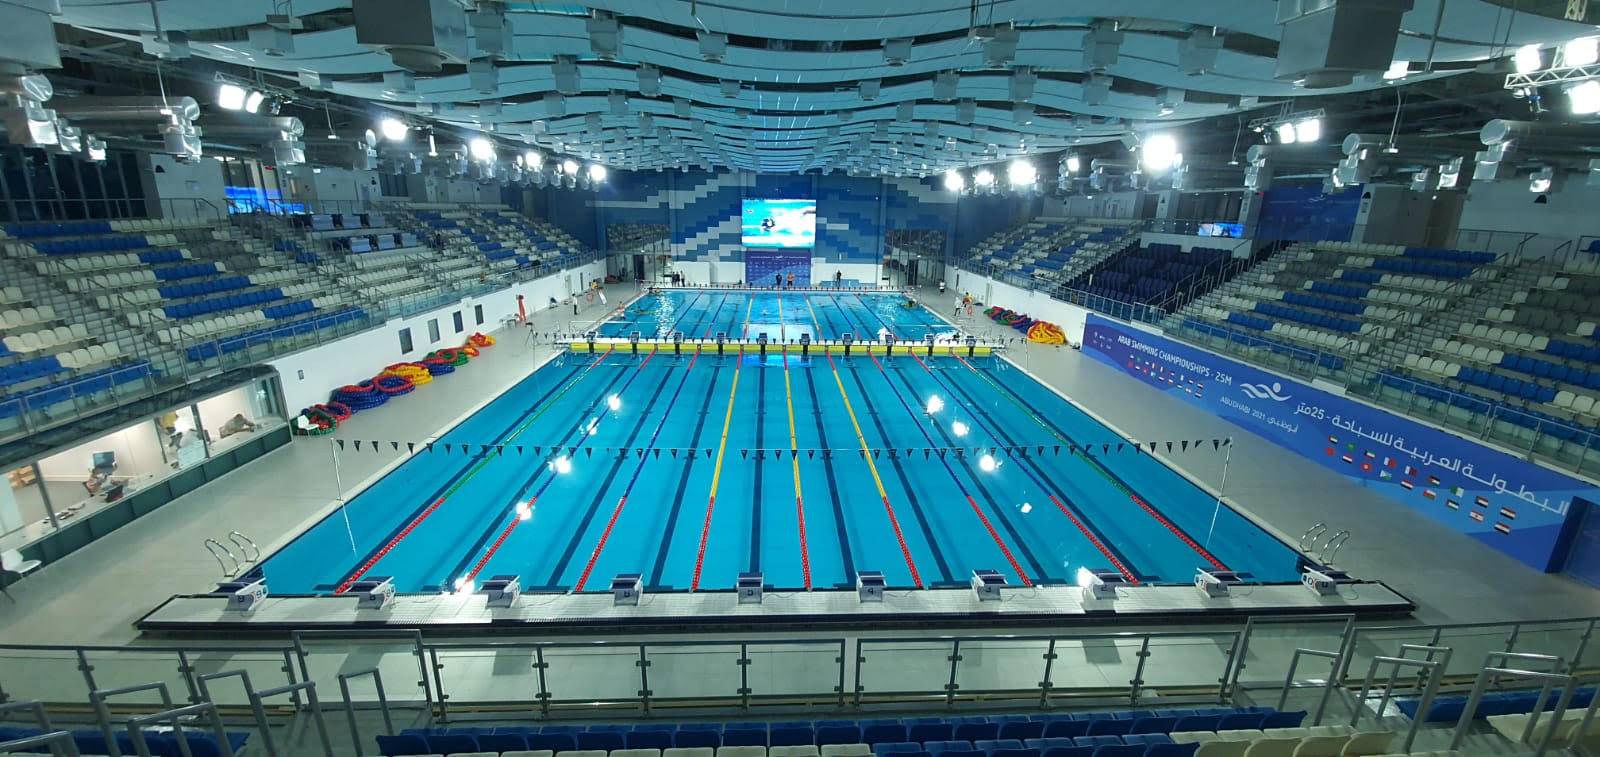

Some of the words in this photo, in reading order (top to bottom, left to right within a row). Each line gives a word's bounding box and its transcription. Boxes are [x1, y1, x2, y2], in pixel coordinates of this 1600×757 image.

[1118, 335, 1131, 346] ARAB
[1131, 340, 1158, 357] SWIMMING
[1159, 350, 1210, 377] CHAMPIONSHIPS
[1215, 371, 1233, 386] 25M
[1252, 409, 1266, 420] 2021
